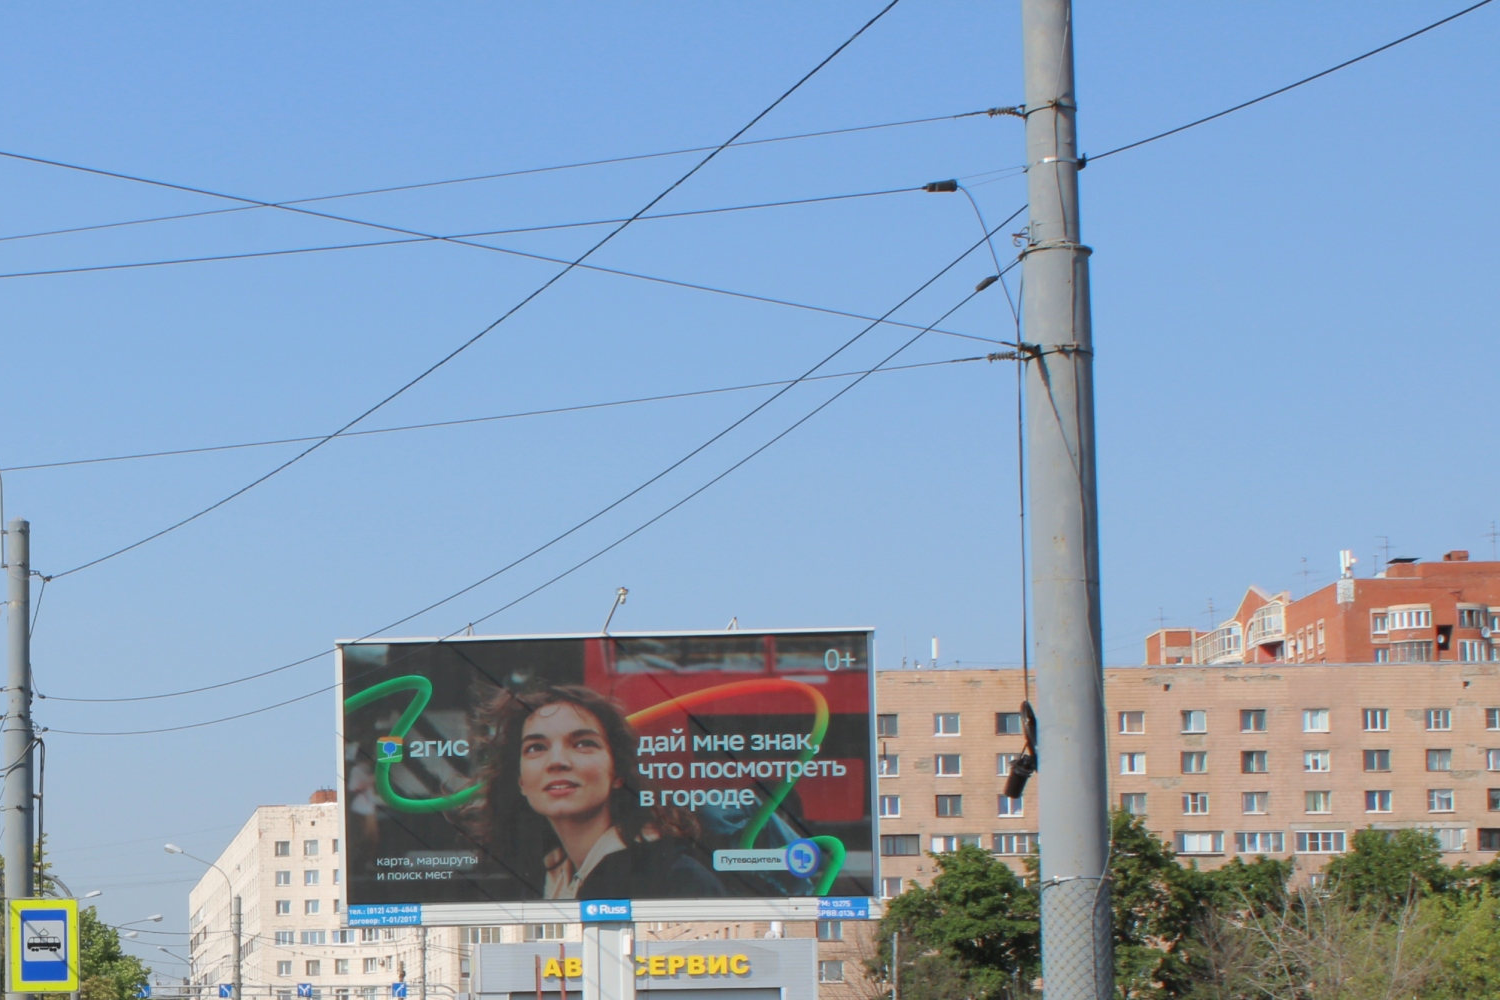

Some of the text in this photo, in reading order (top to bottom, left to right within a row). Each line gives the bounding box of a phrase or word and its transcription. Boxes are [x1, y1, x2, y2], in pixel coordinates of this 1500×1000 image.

[824, 648, 856, 671] 0+
[409, 739, 470, 758] 2ГИС
[637, 728, 820, 756] дай мне знак,
[638, 759, 847, 783] что посмотреть
[640, 787, 756, 812] в городе
[376, 855, 478, 869] карта, маршруты
[720, 855, 782, 865] Путеводитель
[376, 870, 453, 881] и поиск мест
[599, 904, 628, 915] Russ
[543, 953, 751, 978] АВСЕРВИС
